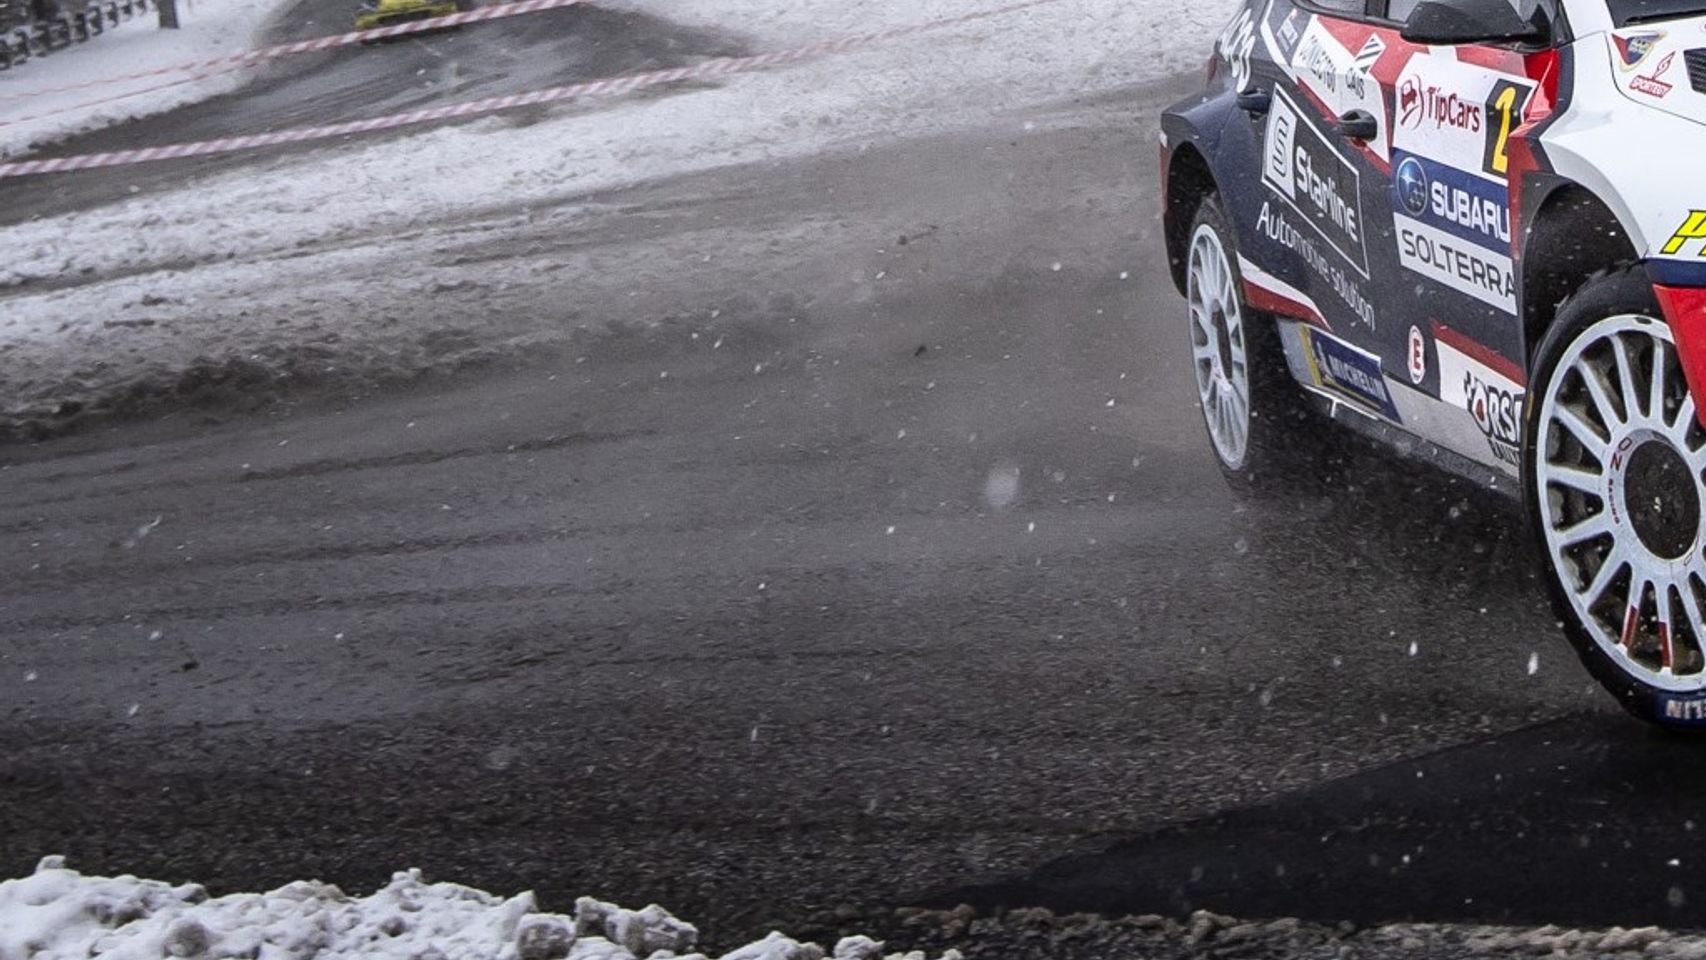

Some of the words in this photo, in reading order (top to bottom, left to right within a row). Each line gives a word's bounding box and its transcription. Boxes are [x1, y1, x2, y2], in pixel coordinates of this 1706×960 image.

[1425, 86, 1481, 133] TipCars
[1295, 144, 1358, 243] Starline
[1430, 181, 1511, 243] SUBARU
[1256, 201, 1330, 283] Automotive
[1330, 263, 1376, 332] solution
[1401, 229, 1517, 299] SOLTERRA
